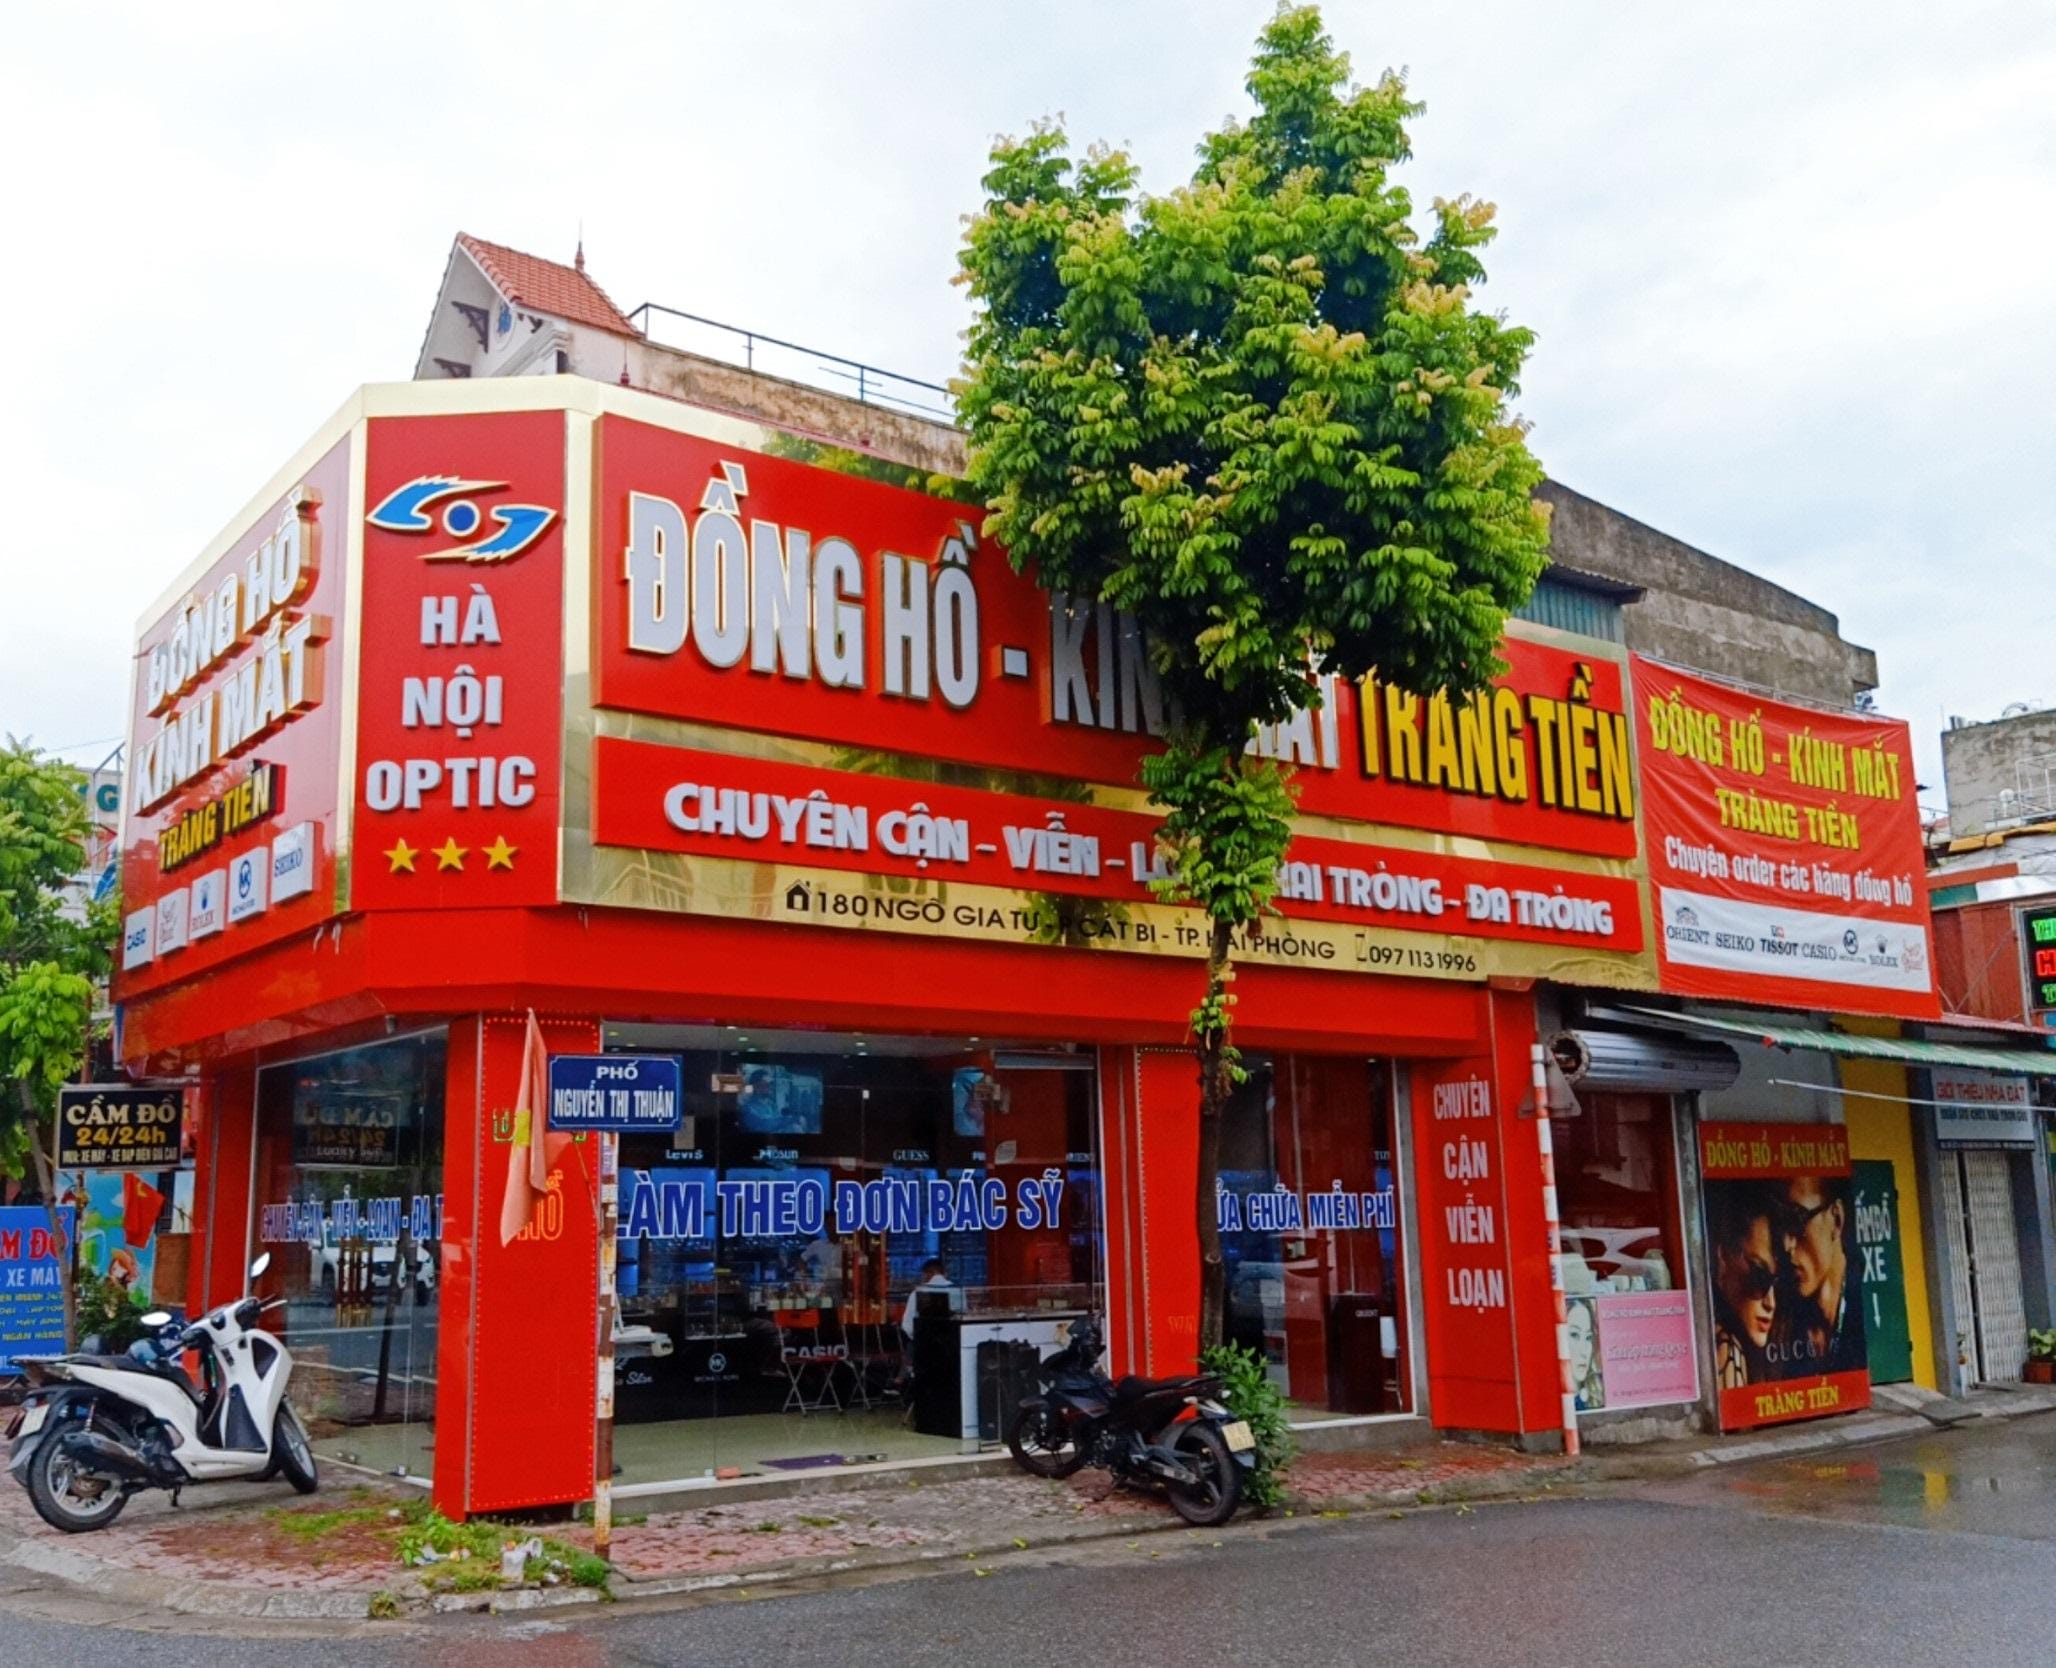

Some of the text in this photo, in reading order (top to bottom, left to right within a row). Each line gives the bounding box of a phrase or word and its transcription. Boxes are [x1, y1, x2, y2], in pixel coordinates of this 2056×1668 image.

[147, 484, 312, 712] ĐỒNG HỒ
[420, 583, 502, 646] HÀ
[624, 459, 866, 690] ĐỒNG
[880, 519, 980, 709] HỒ
[1528, 663, 1635, 819] TIỀN
[133, 611, 318, 815] KÍNH MẮT
[402, 664, 503, 738] NỘI
[1650, 686, 1724, 767] ĐỒNG
[1730, 708, 1765, 776] HỒ
[1788, 726, 1847, 792] KÍNH
[1852, 736, 1901, 800] MẮT
[365, 756, 537, 812] OPTIC
[158, 760, 273, 870] TRÀNG TIỀN
[1715, 788, 1860, 850] TRÀNG TIỀN
[663, 782, 869, 851] CHUYÊN
[875, 802, 970, 868] CẬN
[1002, 811, 1099, 876] VIỄN
[1328, 860, 1444, 915] TRÒNG
[1465, 883, 1512, 924] ĐA
[1512, 884, 1615, 935] TRÒNG
[1664, 835, 1913, 906] Chuyên order các hãng đồng hồ
[818, 891, 869, 918] 180
[875, 896, 946, 923] NGÔ
[953, 905, 1005, 929] GIA
[1010, 910, 1040, 937] TỰ
[1079, 914, 1128, 940] CÁT
[1136, 923, 1155, 942] BI
[1175, 926, 1200, 947] TP.
[1253, 931, 1335, 960] PHÒNG
[1666, 925, 1710, 946] ORIENT
[1715, 932, 1755, 953] SEIKO
[1759, 938, 1799, 957] TISSOT
[1801, 945, 1838, 962] CASIO
[596, 1059, 639, 1080] PHỐ
[66, 1093, 176, 1125] CẦM ĐỒ
[610, 1090, 629, 1123] THỊ
[633, 1085, 675, 1123] THUẬN
[1433, 1073, 1491, 1120] CHUYÊN
[76, 1125, 167, 1146] 24/24h
[1443, 1134, 1488, 1186] CẬN
[411, 1195, 431, 1240] ĐA
[717, 1179, 826, 1238] THEO
[833, 1177, 921, 1234] ĐƠN
[928, 1169, 1007, 1232] BÁC
[1016, 1168, 1065, 1230] SỸ
[1247, 1183, 1303, 1231] CHỮA
[1307, 1179, 1359, 1229] MIỄN
[1362, 1185, 1395, 1229] PHÍ
[1445, 1193, 1495, 1244] VIỄN
[6, 1267, 27, 1288] XE
[1861, 1246, 1887, 1283] XE
[1447, 1268, 1505, 1314] LOẠN
[1755, 1376, 1839, 1417] TRÀNG TIỀN
